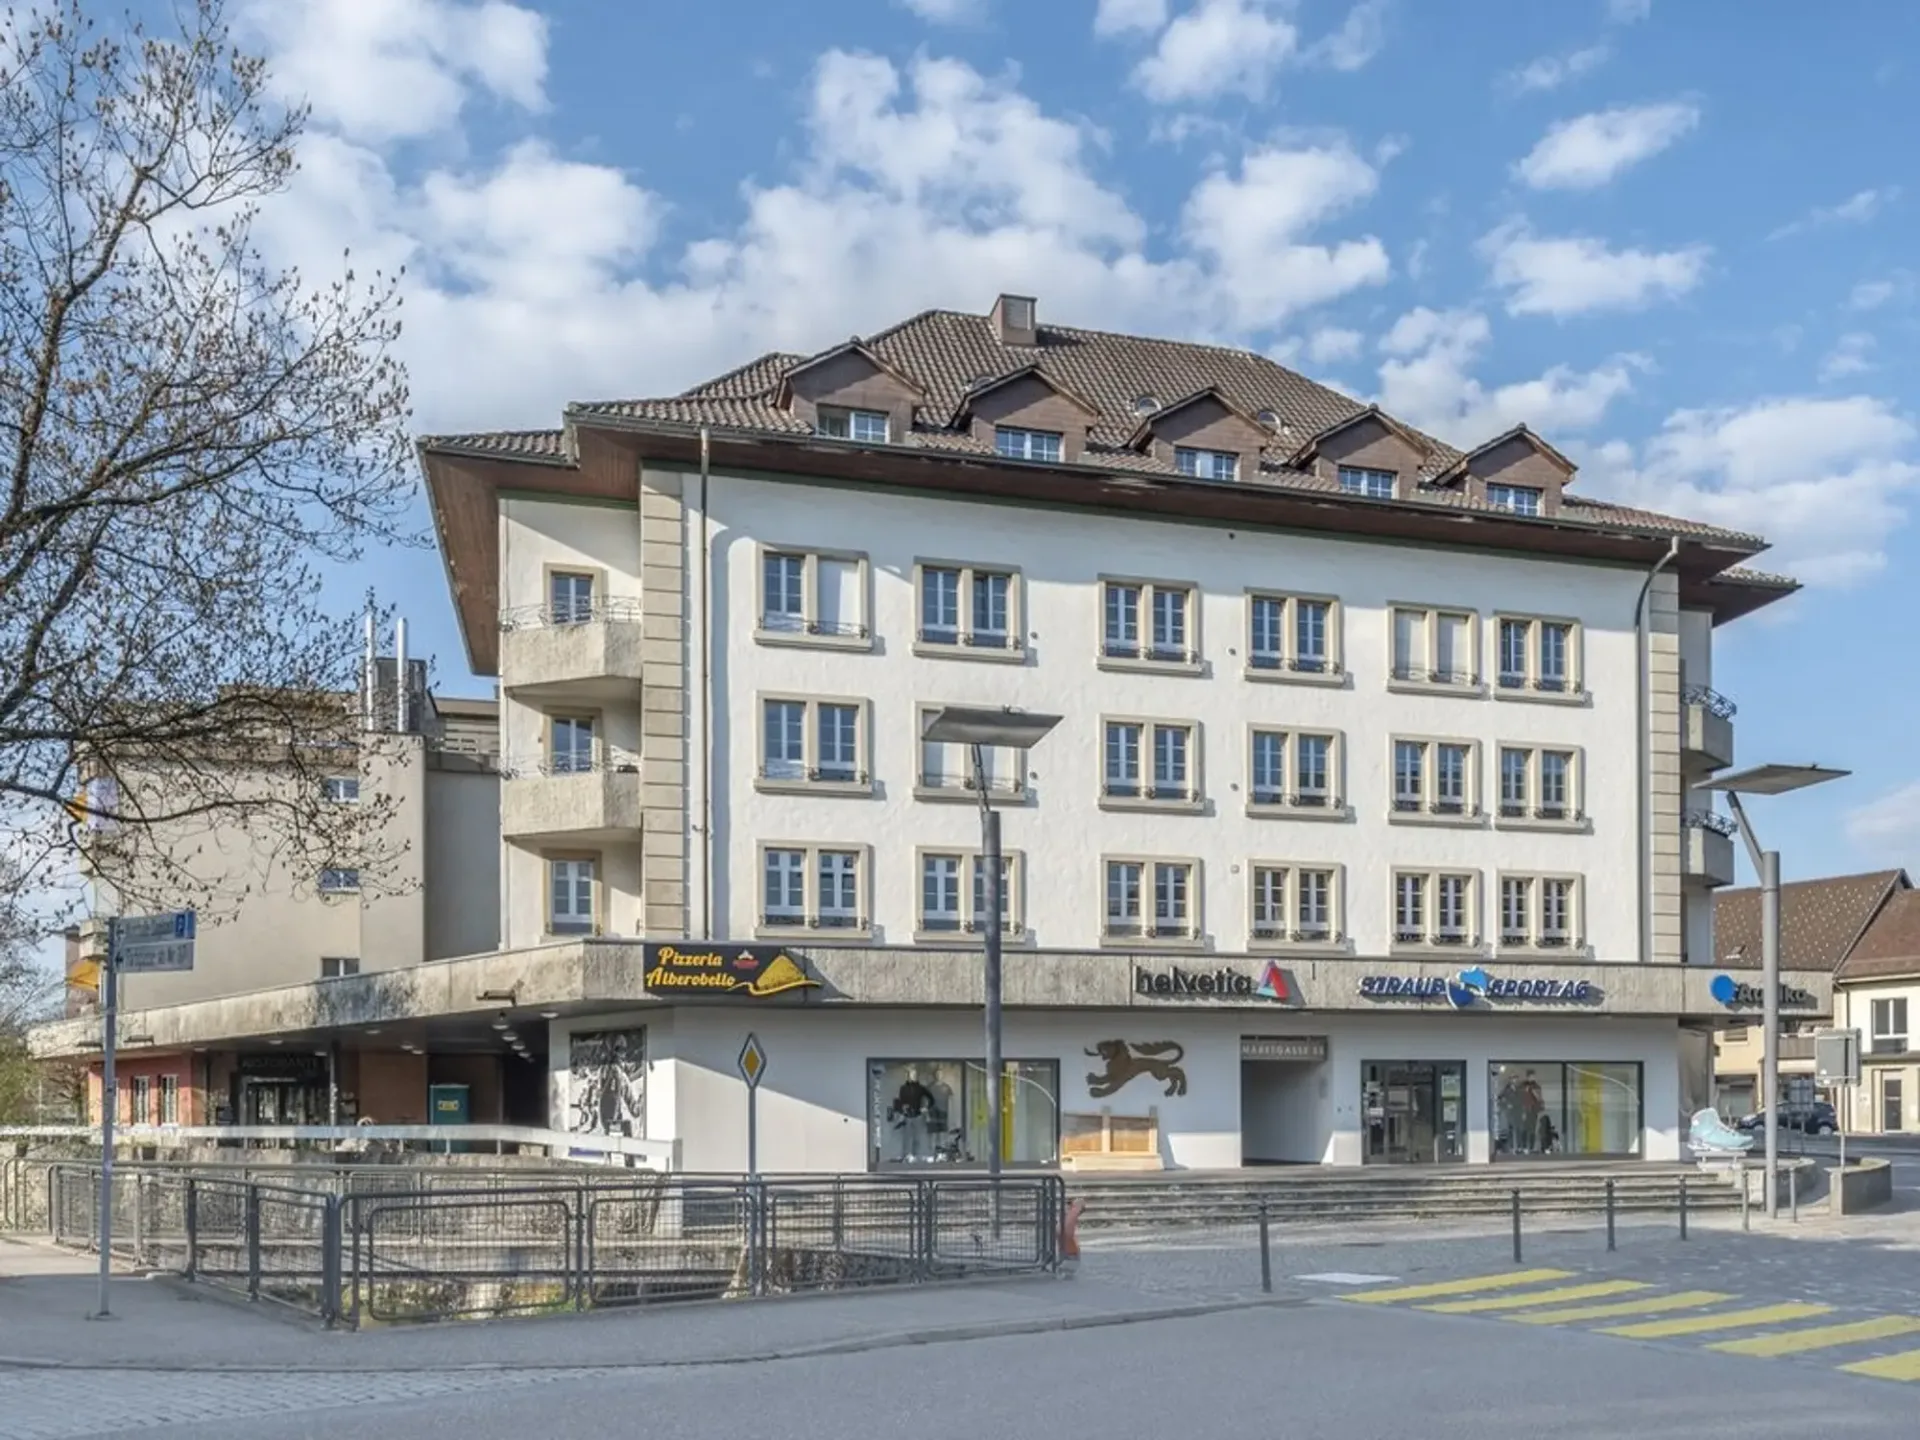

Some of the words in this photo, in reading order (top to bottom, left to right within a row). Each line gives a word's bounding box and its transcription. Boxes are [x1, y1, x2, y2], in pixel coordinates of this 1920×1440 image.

[658, 946, 723, 967] Pizzeria
[646, 967, 736, 988] Alberobello
[1132, 965, 1253, 994] helvetia
[1358, 976, 1447, 997] STRAUB
[1485, 978, 1560, 997] SPORT
[1557, 980, 1590, 998] AG
[1738, 983, 1807, 1002] Auika
